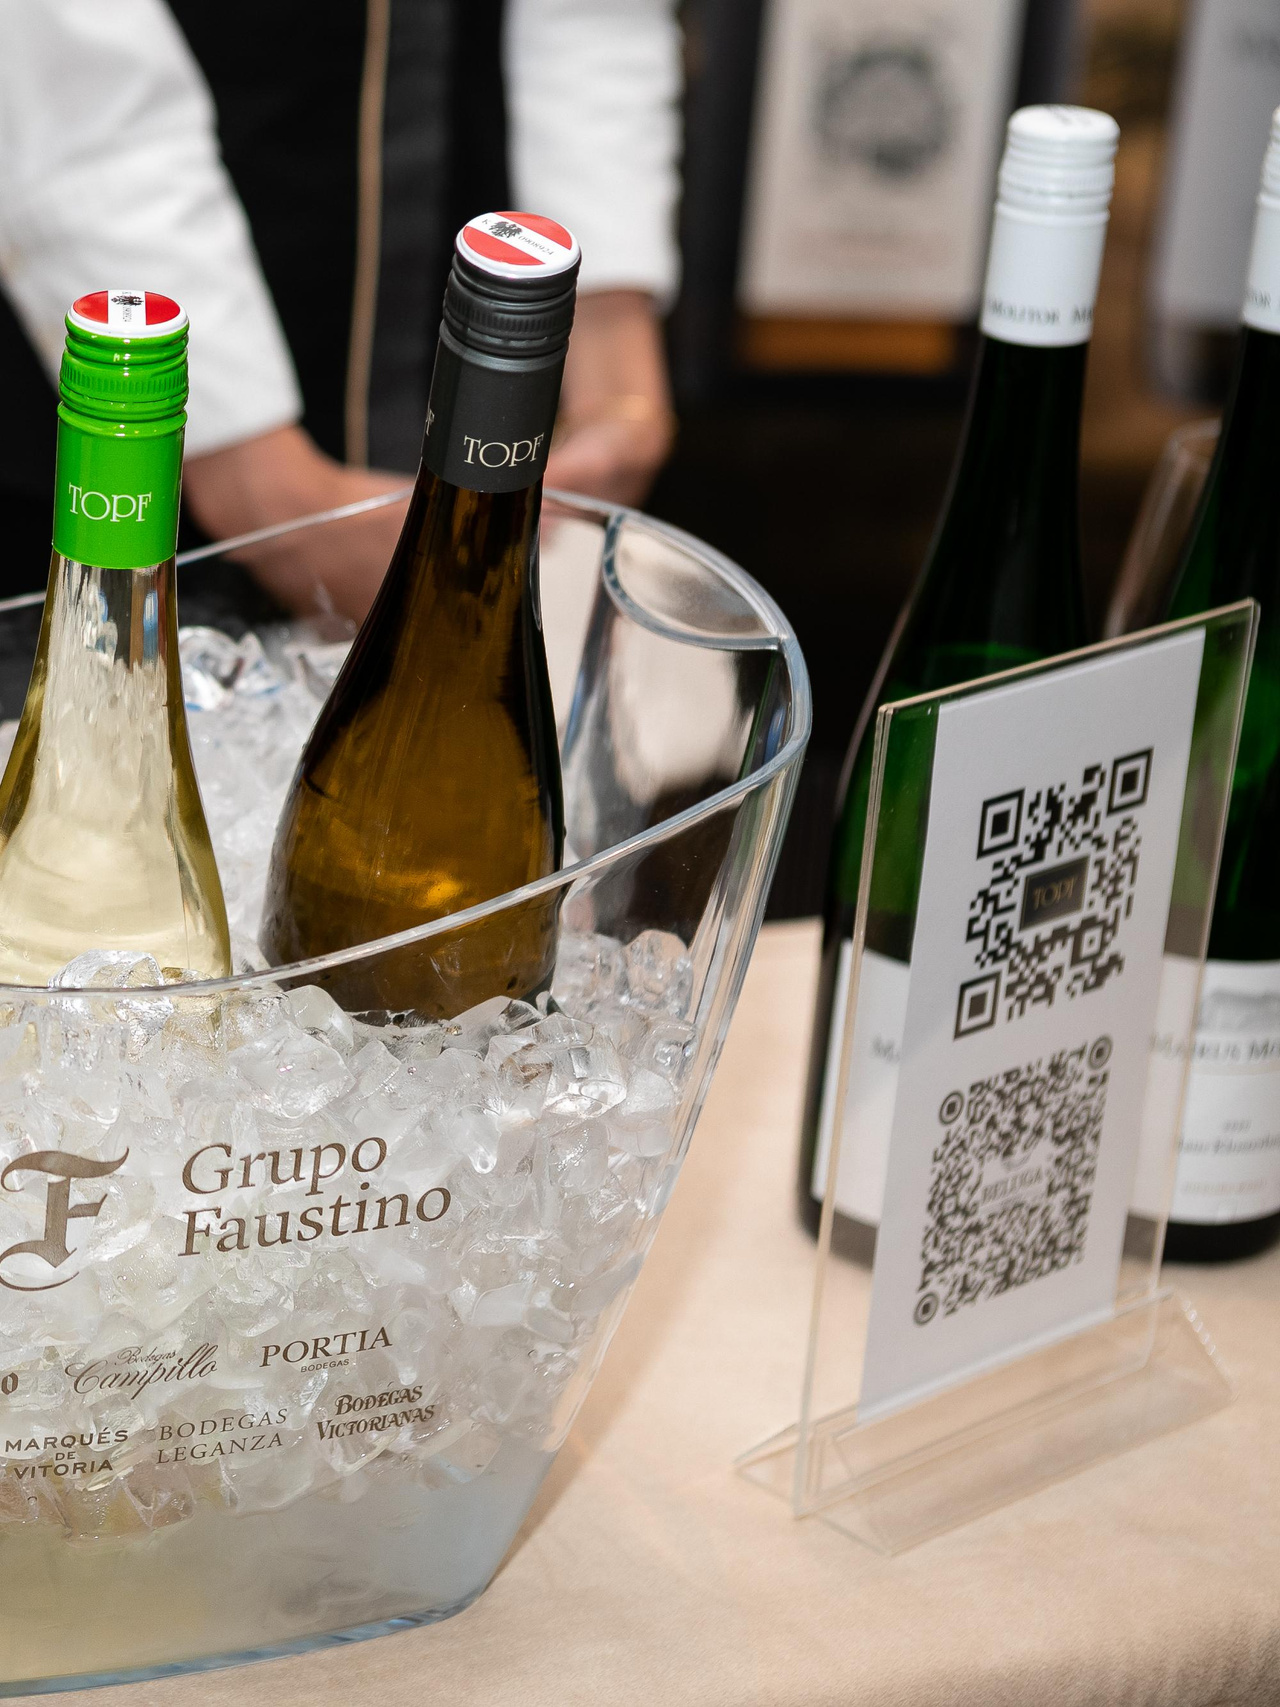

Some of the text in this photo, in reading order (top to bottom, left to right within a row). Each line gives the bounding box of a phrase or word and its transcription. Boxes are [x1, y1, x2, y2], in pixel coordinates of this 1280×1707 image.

[463, 433, 545, 468] TOPF
[68, 482, 152, 522] TOPF
[181, 1136, 389, 1196] Grupo
[177, 1182, 453, 1258] Faustino
[114, 1346, 177, 1366] Bodegas
[259, 1326, 393, 1368] PORTIA
[64, 1342, 220, 1400] Campillo
[300, 1358, 350, 1373] BODEGAS
[5, 1426, 129, 1452] MARQUÉS
[159, 1408, 288, 1441] BODEGAS
[316, 1405, 435, 1441] VICTORIANAS
[55, 1451, 76, 1461] DE
[156, 1433, 284, 1465] LEGANZA
[13, 1459, 114, 1480] VITORIA
